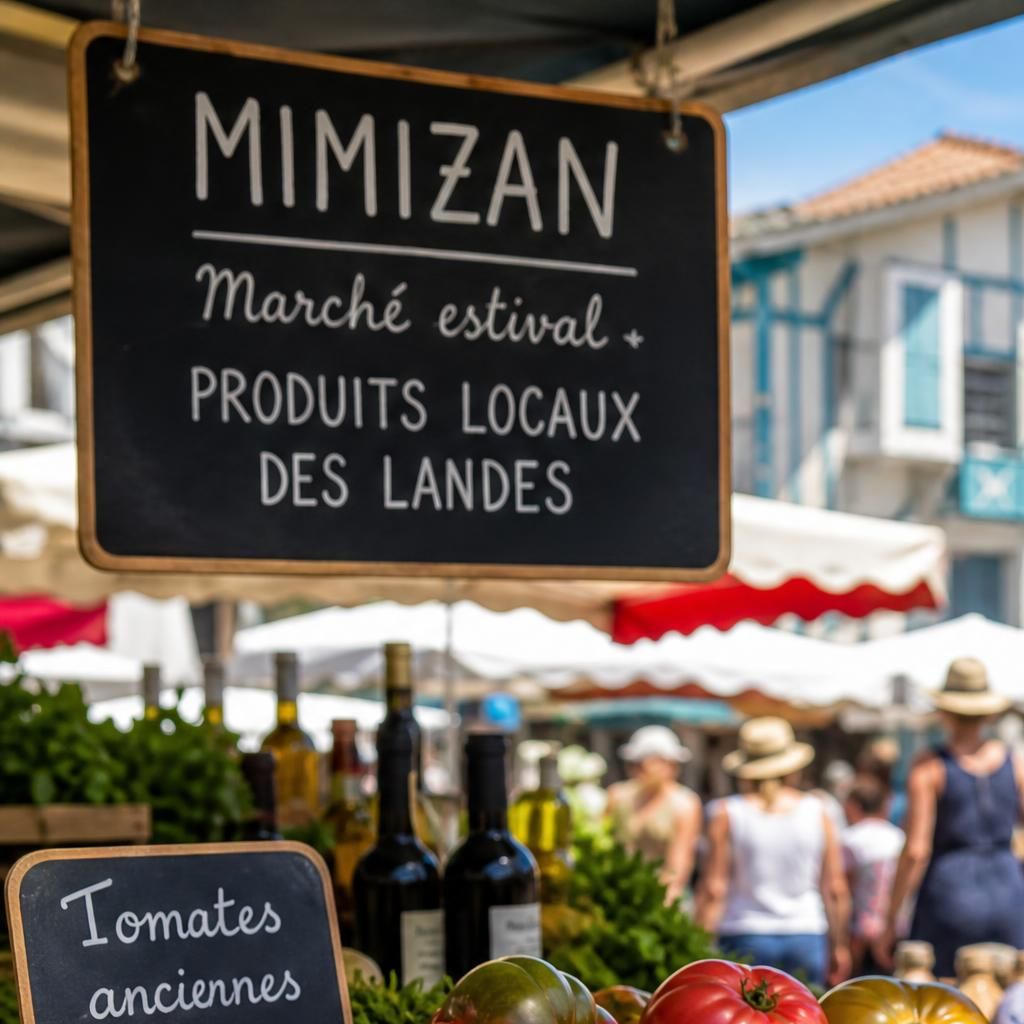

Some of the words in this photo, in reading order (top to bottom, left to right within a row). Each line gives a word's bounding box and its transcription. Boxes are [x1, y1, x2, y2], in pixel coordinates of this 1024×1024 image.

[197, 92, 619, 239] MIMIZAN
[196, 262, 411, 334] Marché
[437, 287, 608, 350] estival
[191, 366, 428, 433] PRODUITS
[461, 382, 642, 443] LOCAUX
[260, 451, 348, 507] DES
[383, 455, 573, 515] LANDES
[61, 878, 282, 947] Tomates
[89, 967, 301, 1020] anciennes
